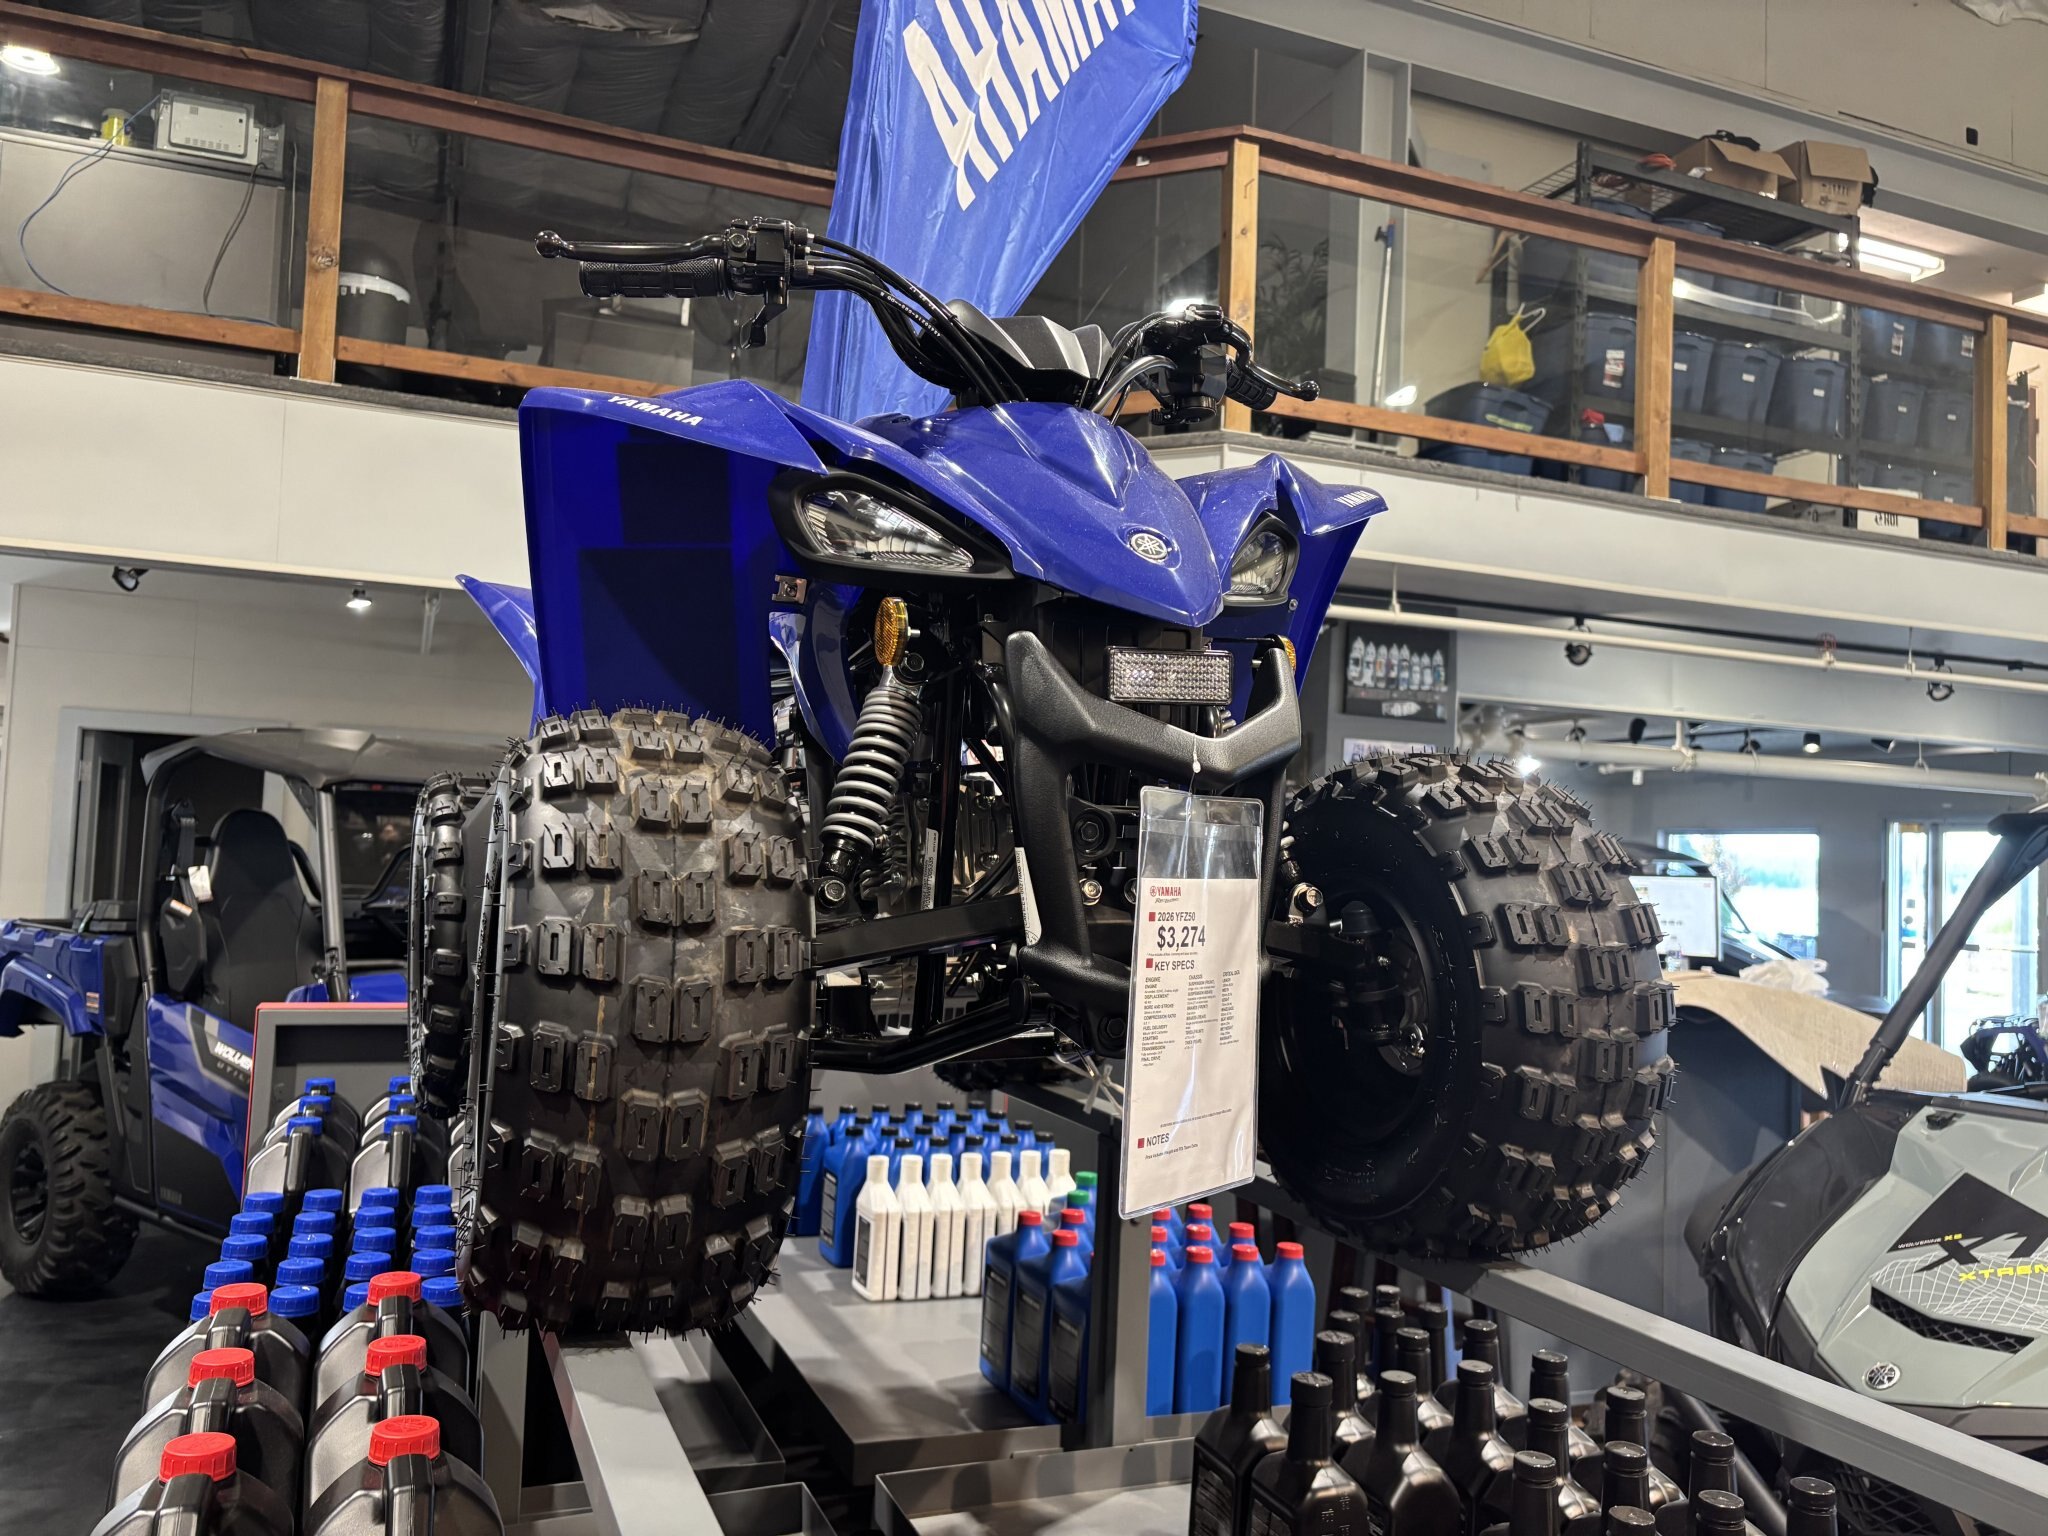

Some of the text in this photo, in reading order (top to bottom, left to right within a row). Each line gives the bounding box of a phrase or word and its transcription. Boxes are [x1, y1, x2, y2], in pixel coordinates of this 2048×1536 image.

[608, 396, 704, 426] YAMAHA
[1156, 886, 1182, 897] YAMAHA
[1157, 911, 1196, 922] 2026 YFZ50
[1157, 924, 1206, 952] $3,274
[1154, 960, 1195, 972] KEY SPECS
[1146, 1133, 1170, 1147] NOTES
